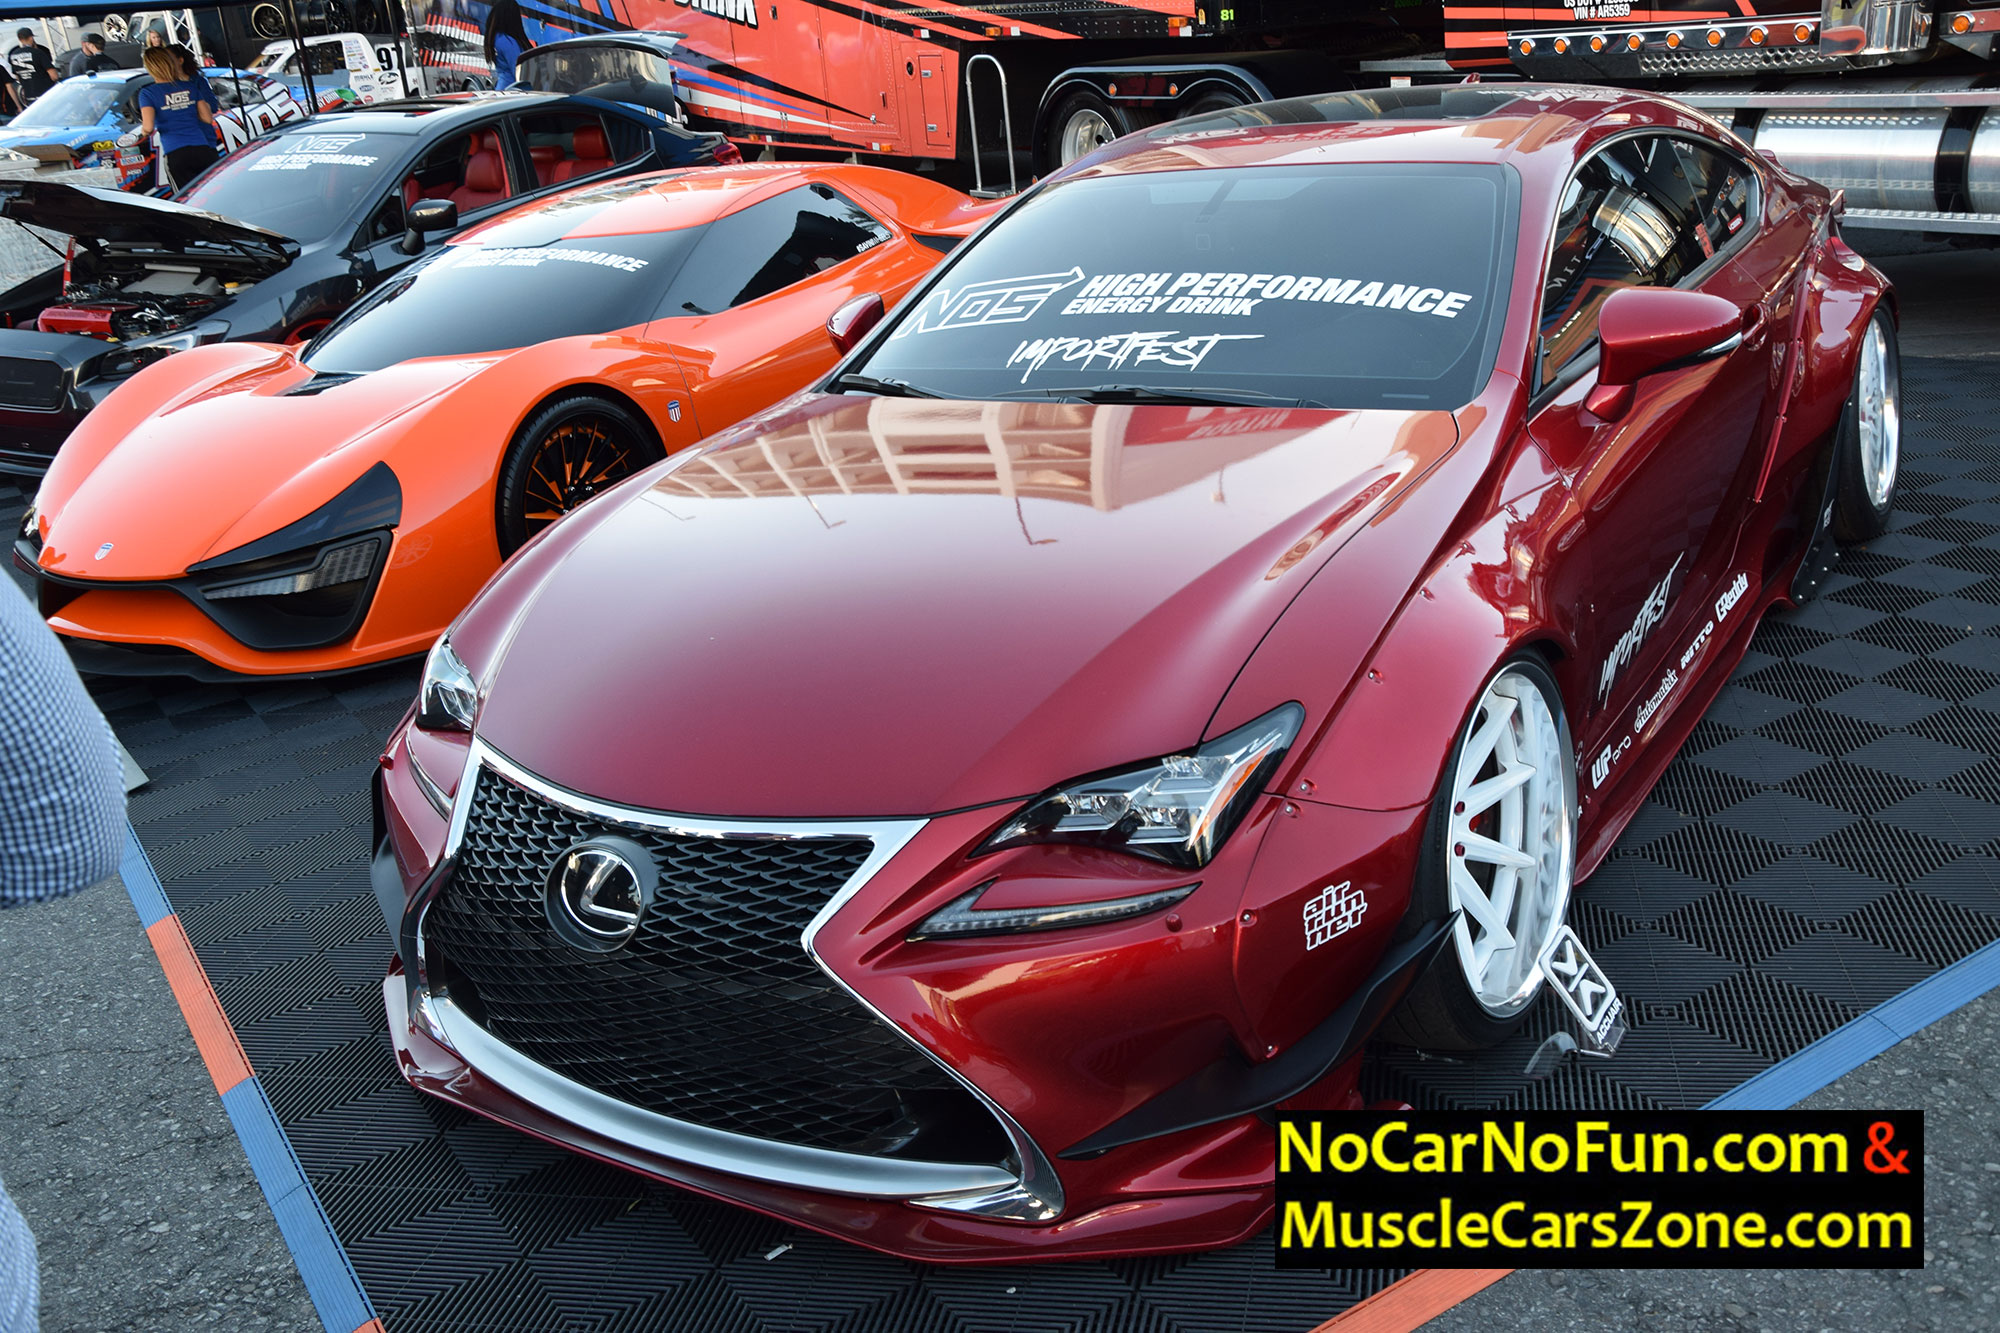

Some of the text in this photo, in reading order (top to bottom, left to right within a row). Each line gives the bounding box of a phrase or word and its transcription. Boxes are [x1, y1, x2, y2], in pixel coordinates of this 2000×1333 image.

[1220, 9, 1234, 20] 81
[1573, 4, 1631, 20] VIN # AR5359
[165, 91, 190, 105] NOS
[213, 81, 304, 151] NOS
[284, 133, 365, 154] NOS
[283, 154, 379, 167] PERFORMANCE
[504, 248, 649, 273] PERFORMANCE
[893, 269, 1080, 340] NOS
[1061, 298, 1265, 317] ENERGY DRINK
[1077, 272, 1473, 319] HIGH PERFORMANCE
[1006, 331, 1265, 385] IMPORTFEST
[1681, 620, 1714, 670] NITTO
[1595, 997, 1624, 1044] ACCUAIR
